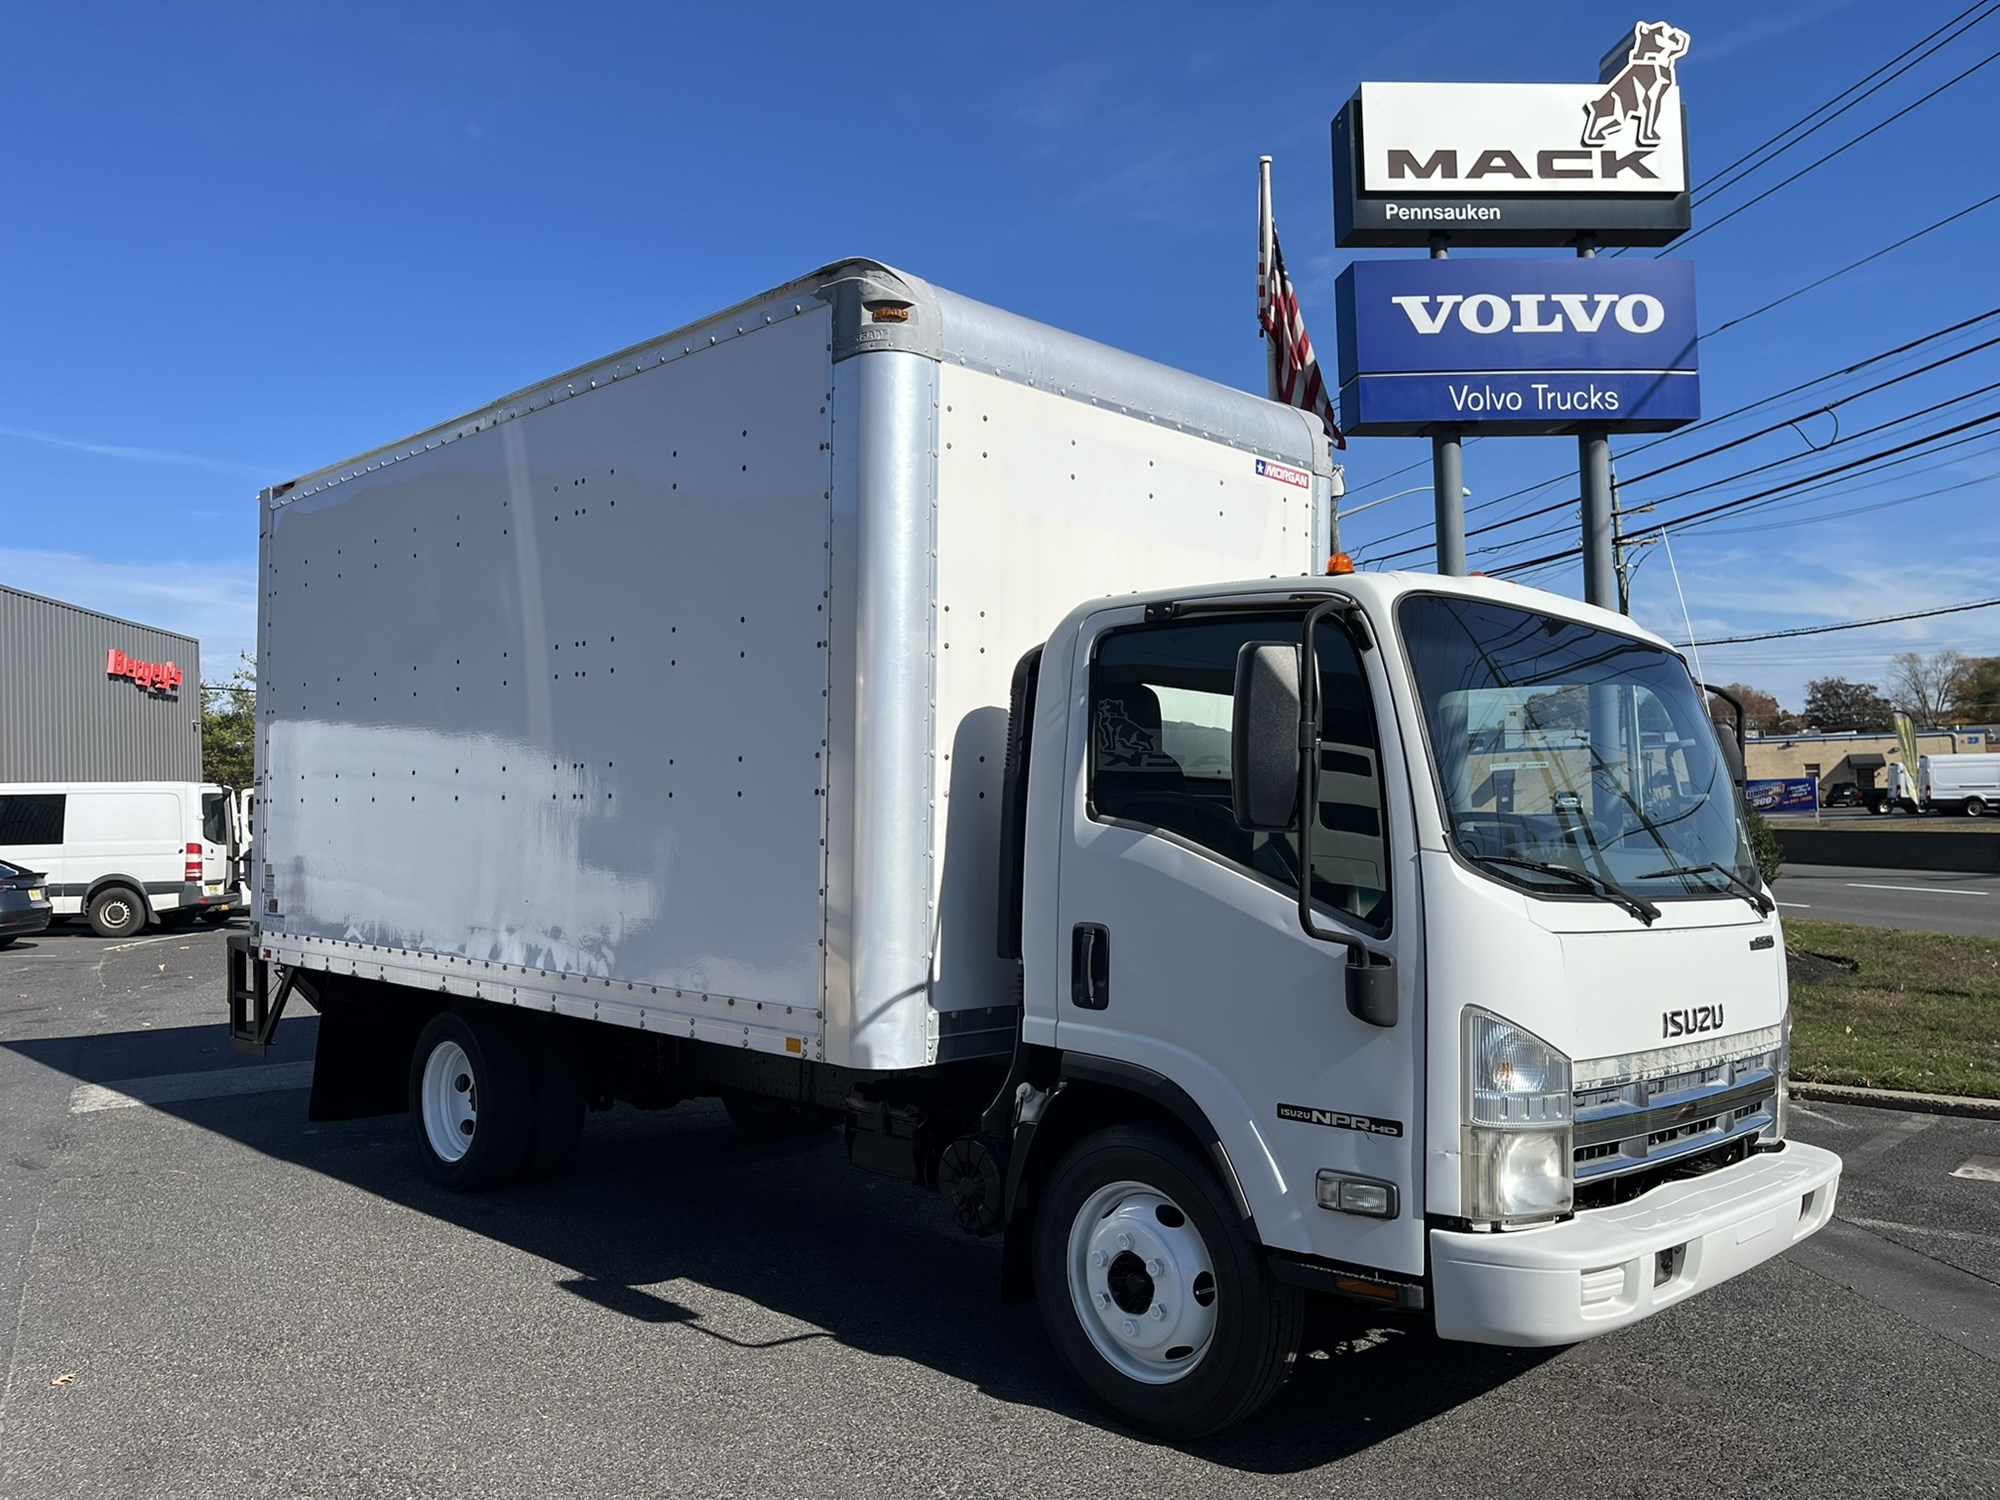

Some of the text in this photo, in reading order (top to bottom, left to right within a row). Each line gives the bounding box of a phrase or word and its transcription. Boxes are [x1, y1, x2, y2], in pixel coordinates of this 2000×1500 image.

[1387, 149, 1660, 180] MACK
[1385, 204, 1501, 221] Pennsauken
[1391, 293, 1665, 335] VOLVO
[1449, 383, 1619, 411] Volvo Trucks
[1265, 464, 1308, 487] MORGAN
[107, 649, 184, 689] Bergey's
[1662, 1003, 1724, 1039] ISUZU
[1280, 1108, 1398, 1135] ISUZU NPR HD
